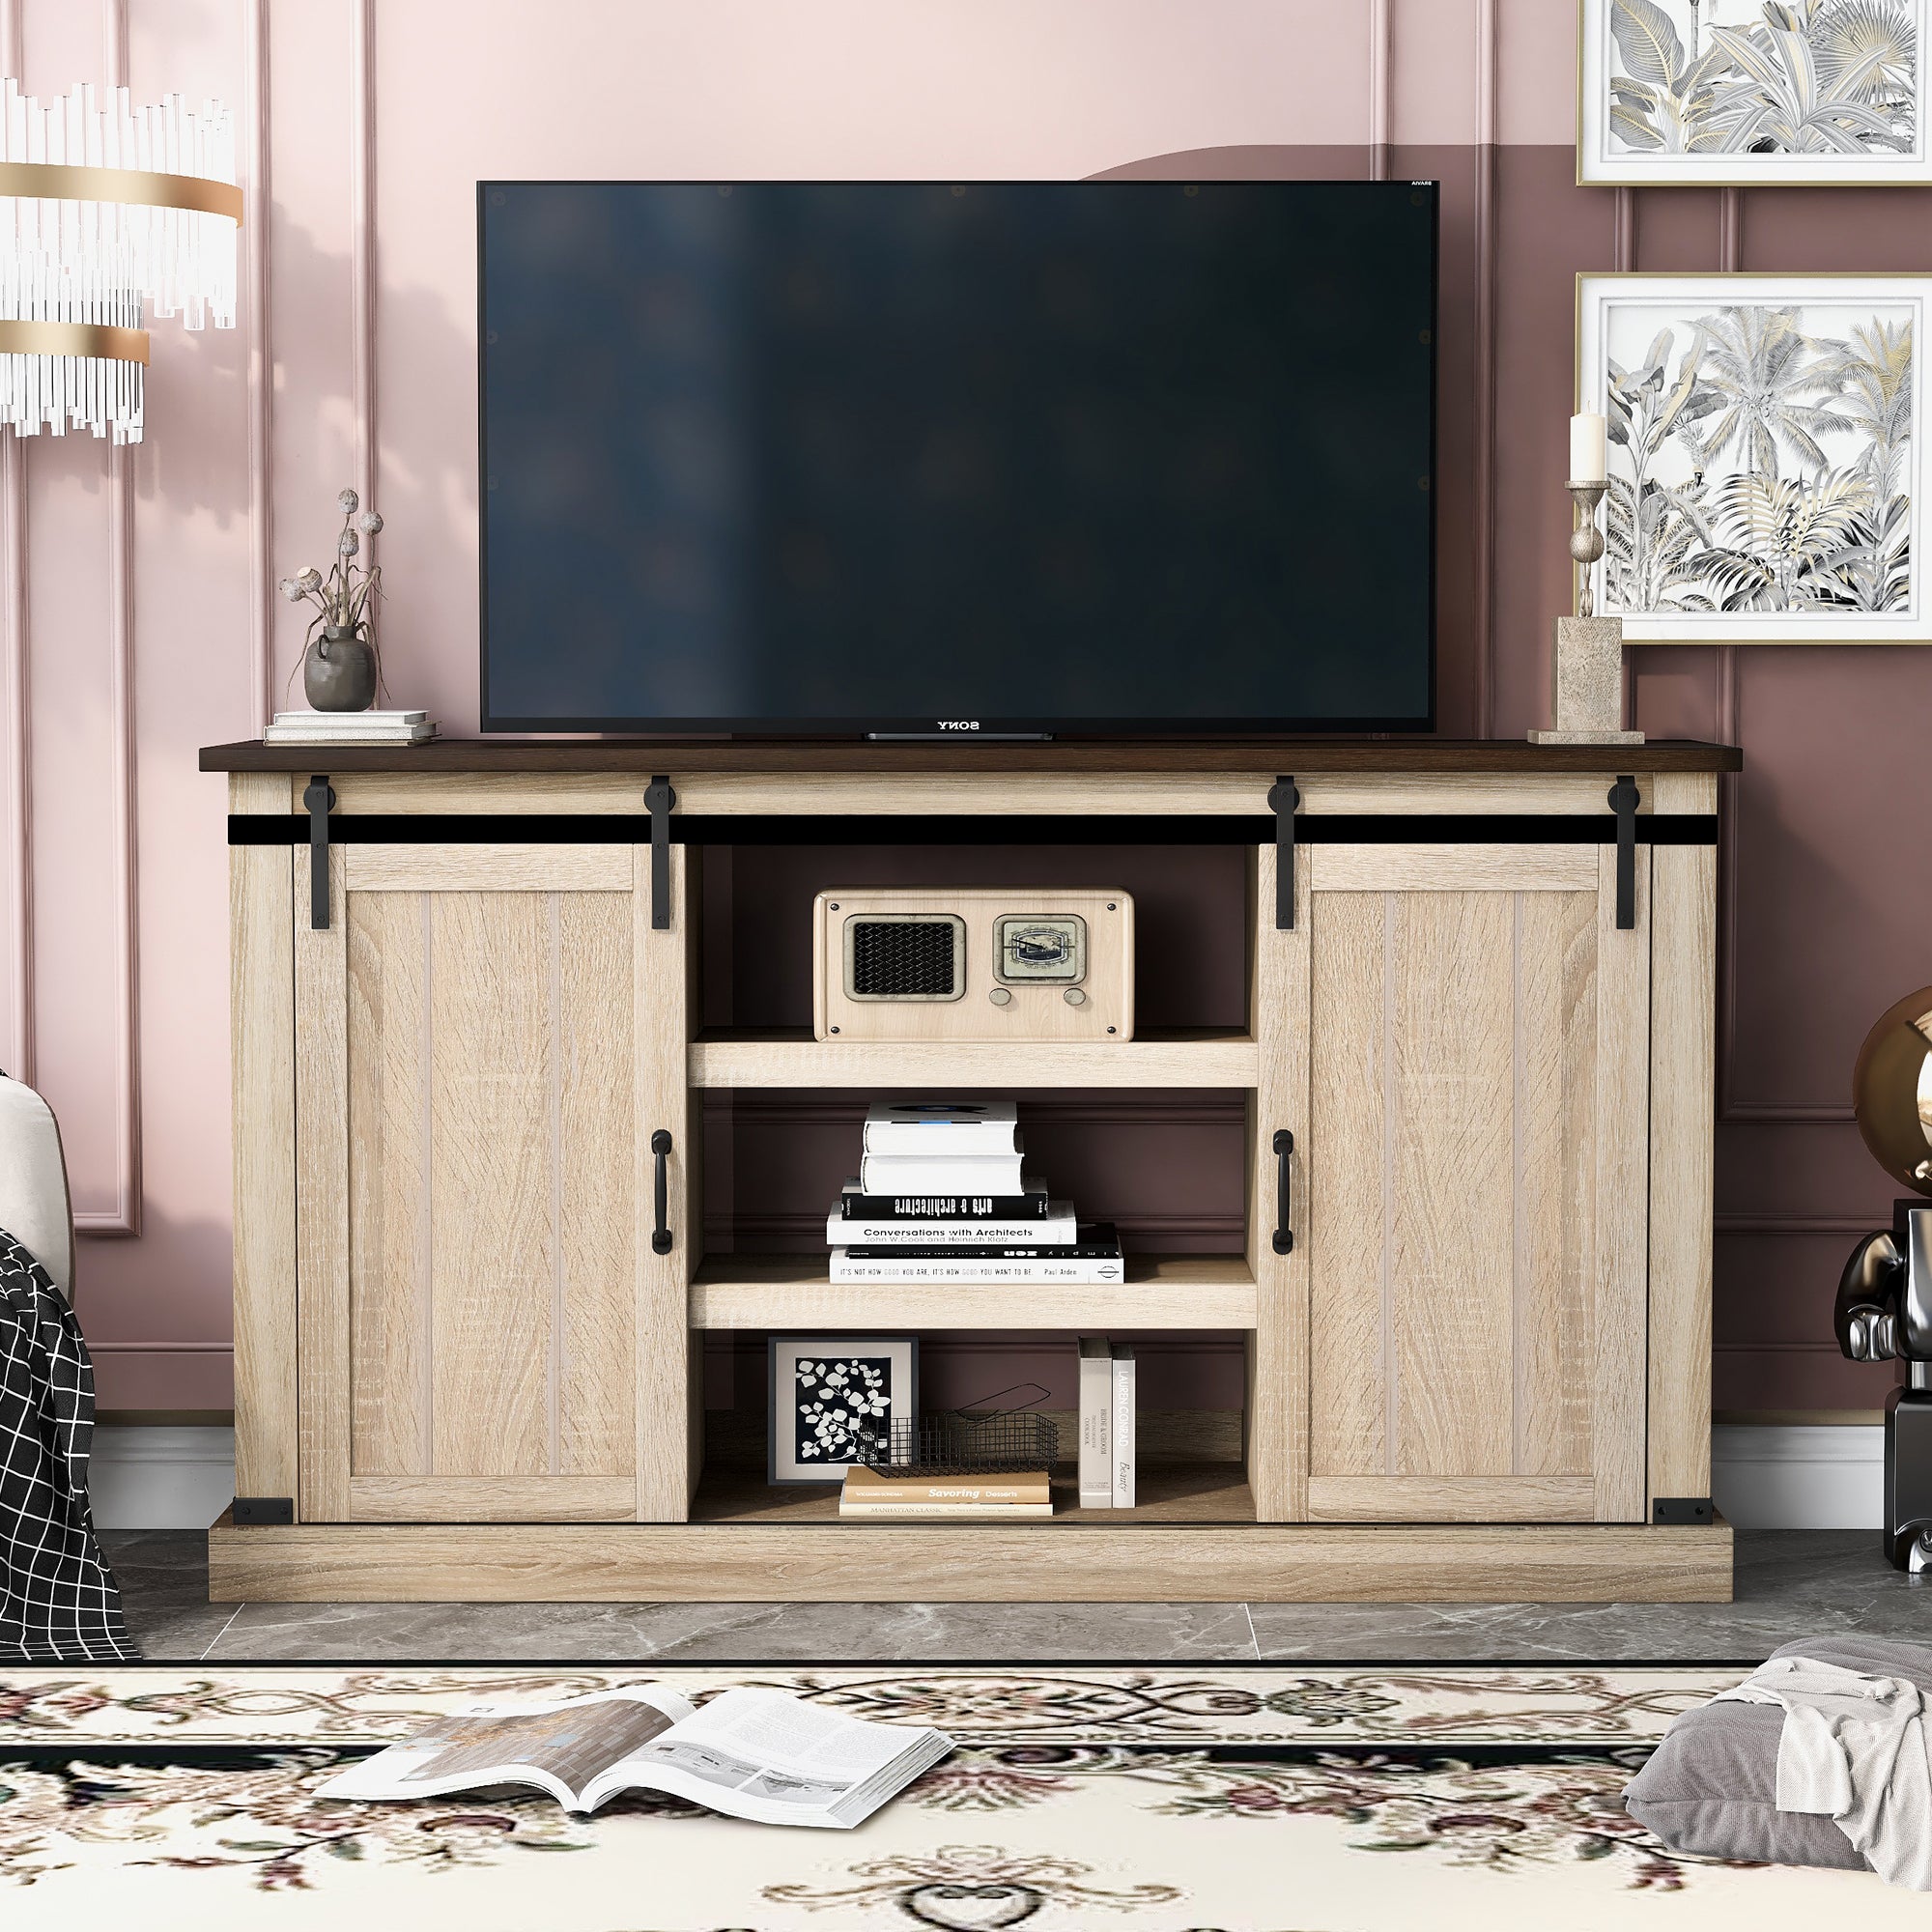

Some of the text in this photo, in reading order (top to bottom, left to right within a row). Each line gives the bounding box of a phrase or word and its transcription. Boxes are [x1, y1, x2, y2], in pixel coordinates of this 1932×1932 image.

[895, 1198, 956, 1216] architecture
[972, 1198, 993, 1216] arts
[1118, 1371, 1129, 1447] LAUREN CONRAD
[1118, 1462, 1130, 1492] Beauty
[928, 1488, 980, 1498] Savoring
